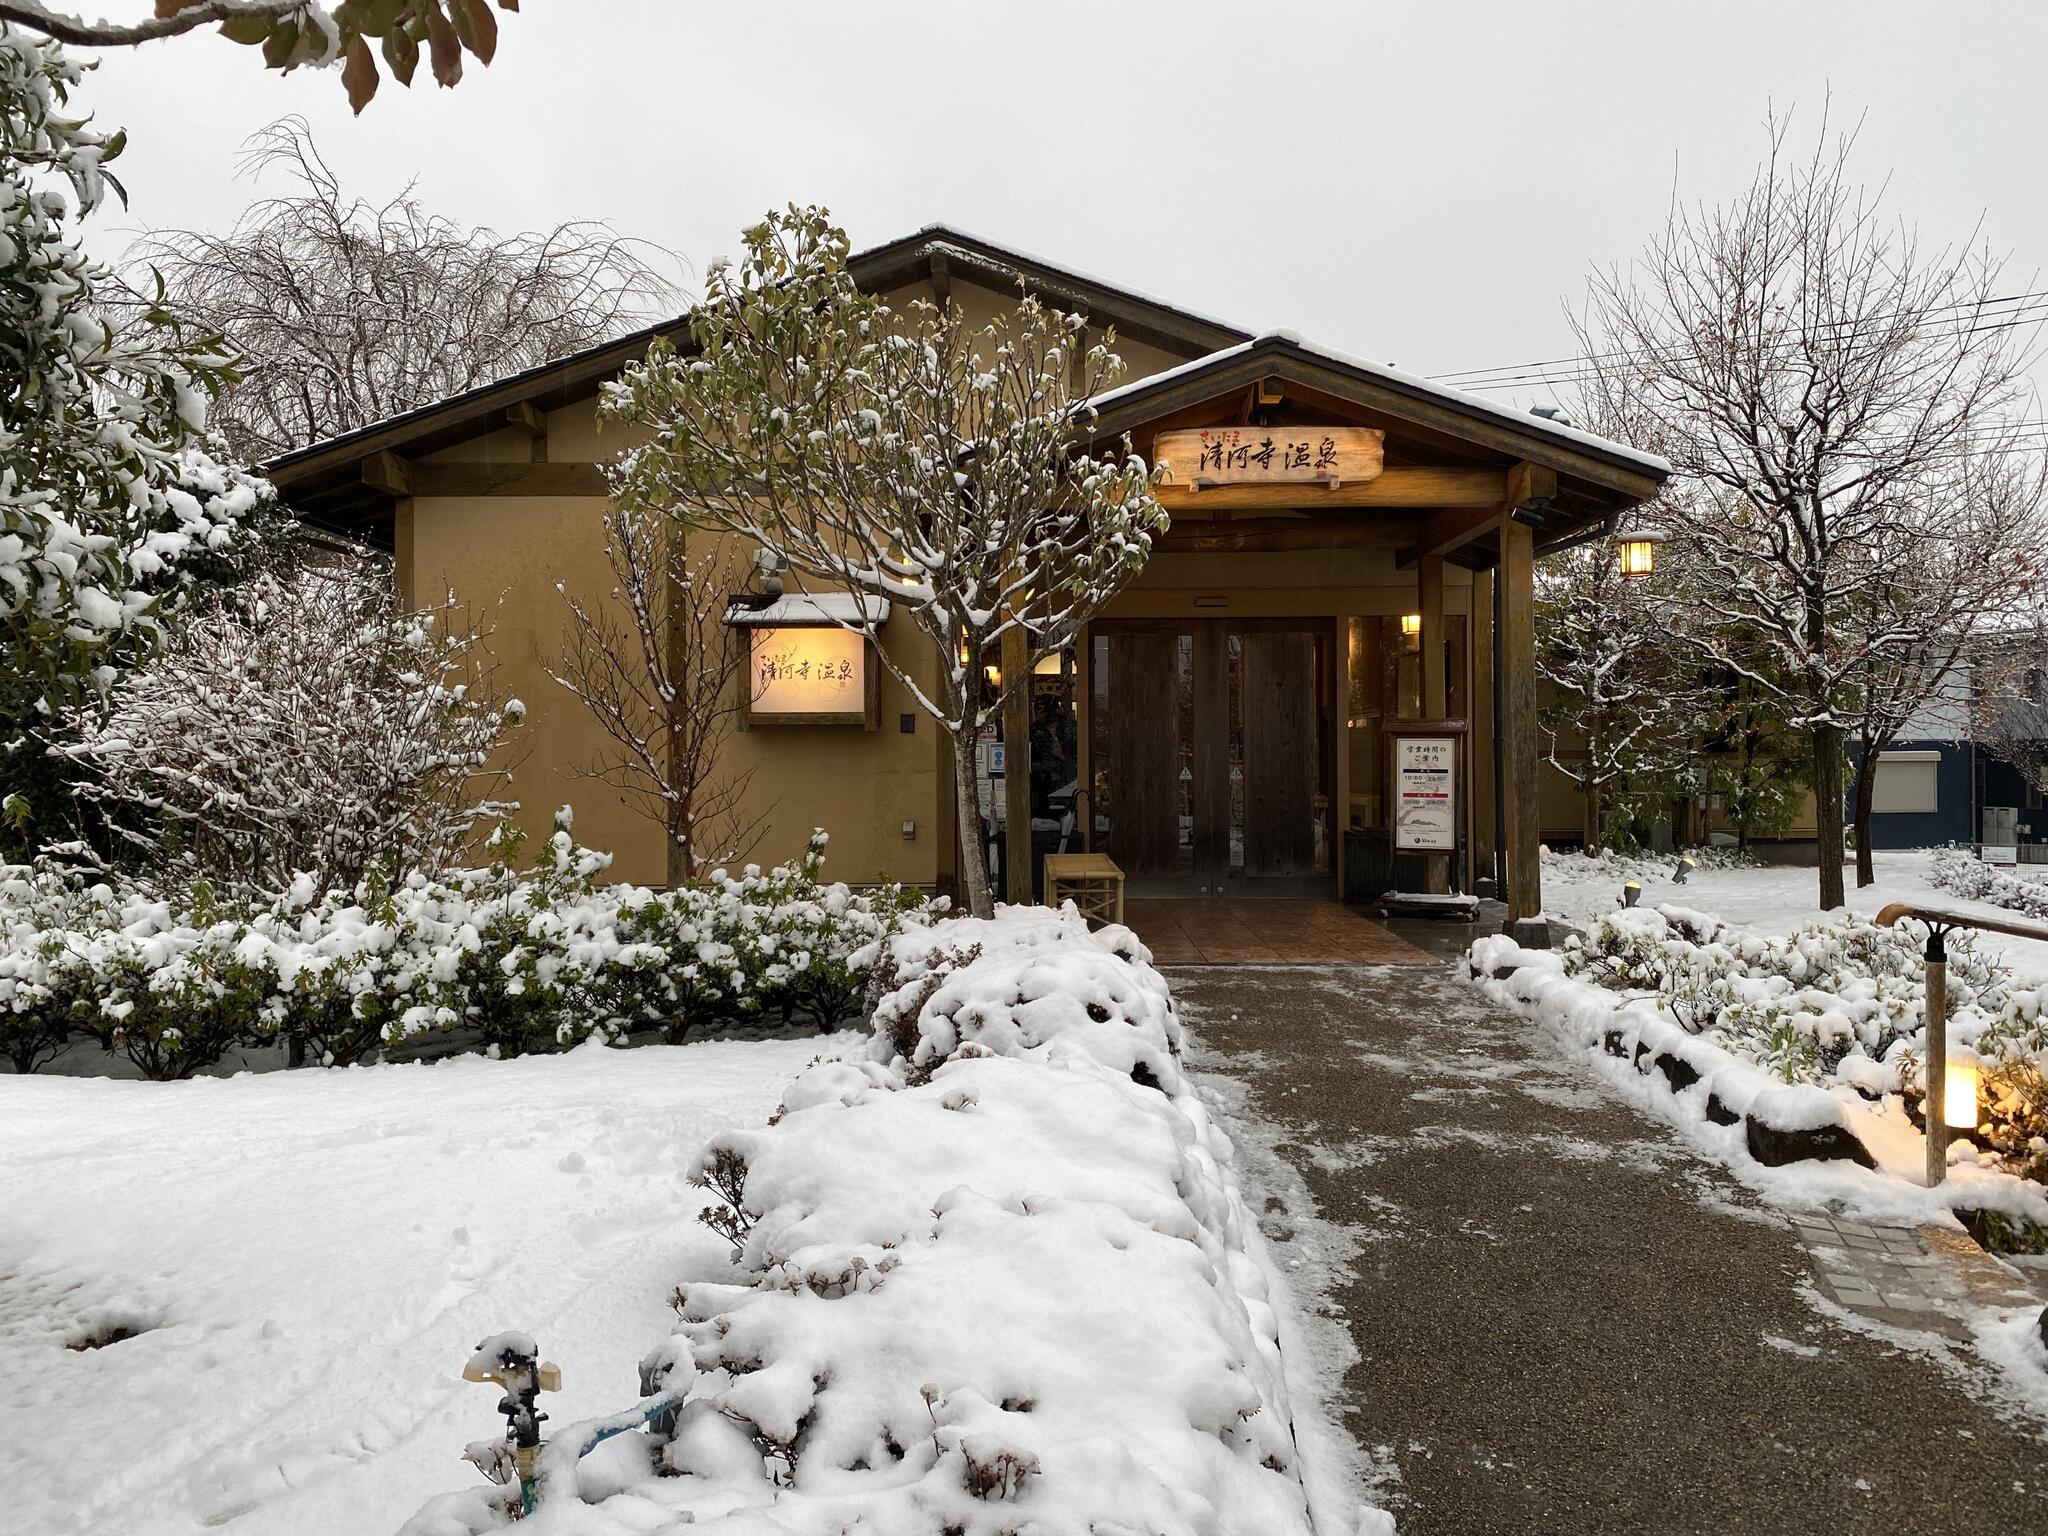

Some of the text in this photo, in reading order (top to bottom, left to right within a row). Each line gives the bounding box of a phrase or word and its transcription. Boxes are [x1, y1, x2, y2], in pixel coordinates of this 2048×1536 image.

[1200, 431, 1240, 442] さいたま
[1201, 437, 1338, 471] 清河寺温泉
[761, 659, 853, 680] 清河寺温泉
